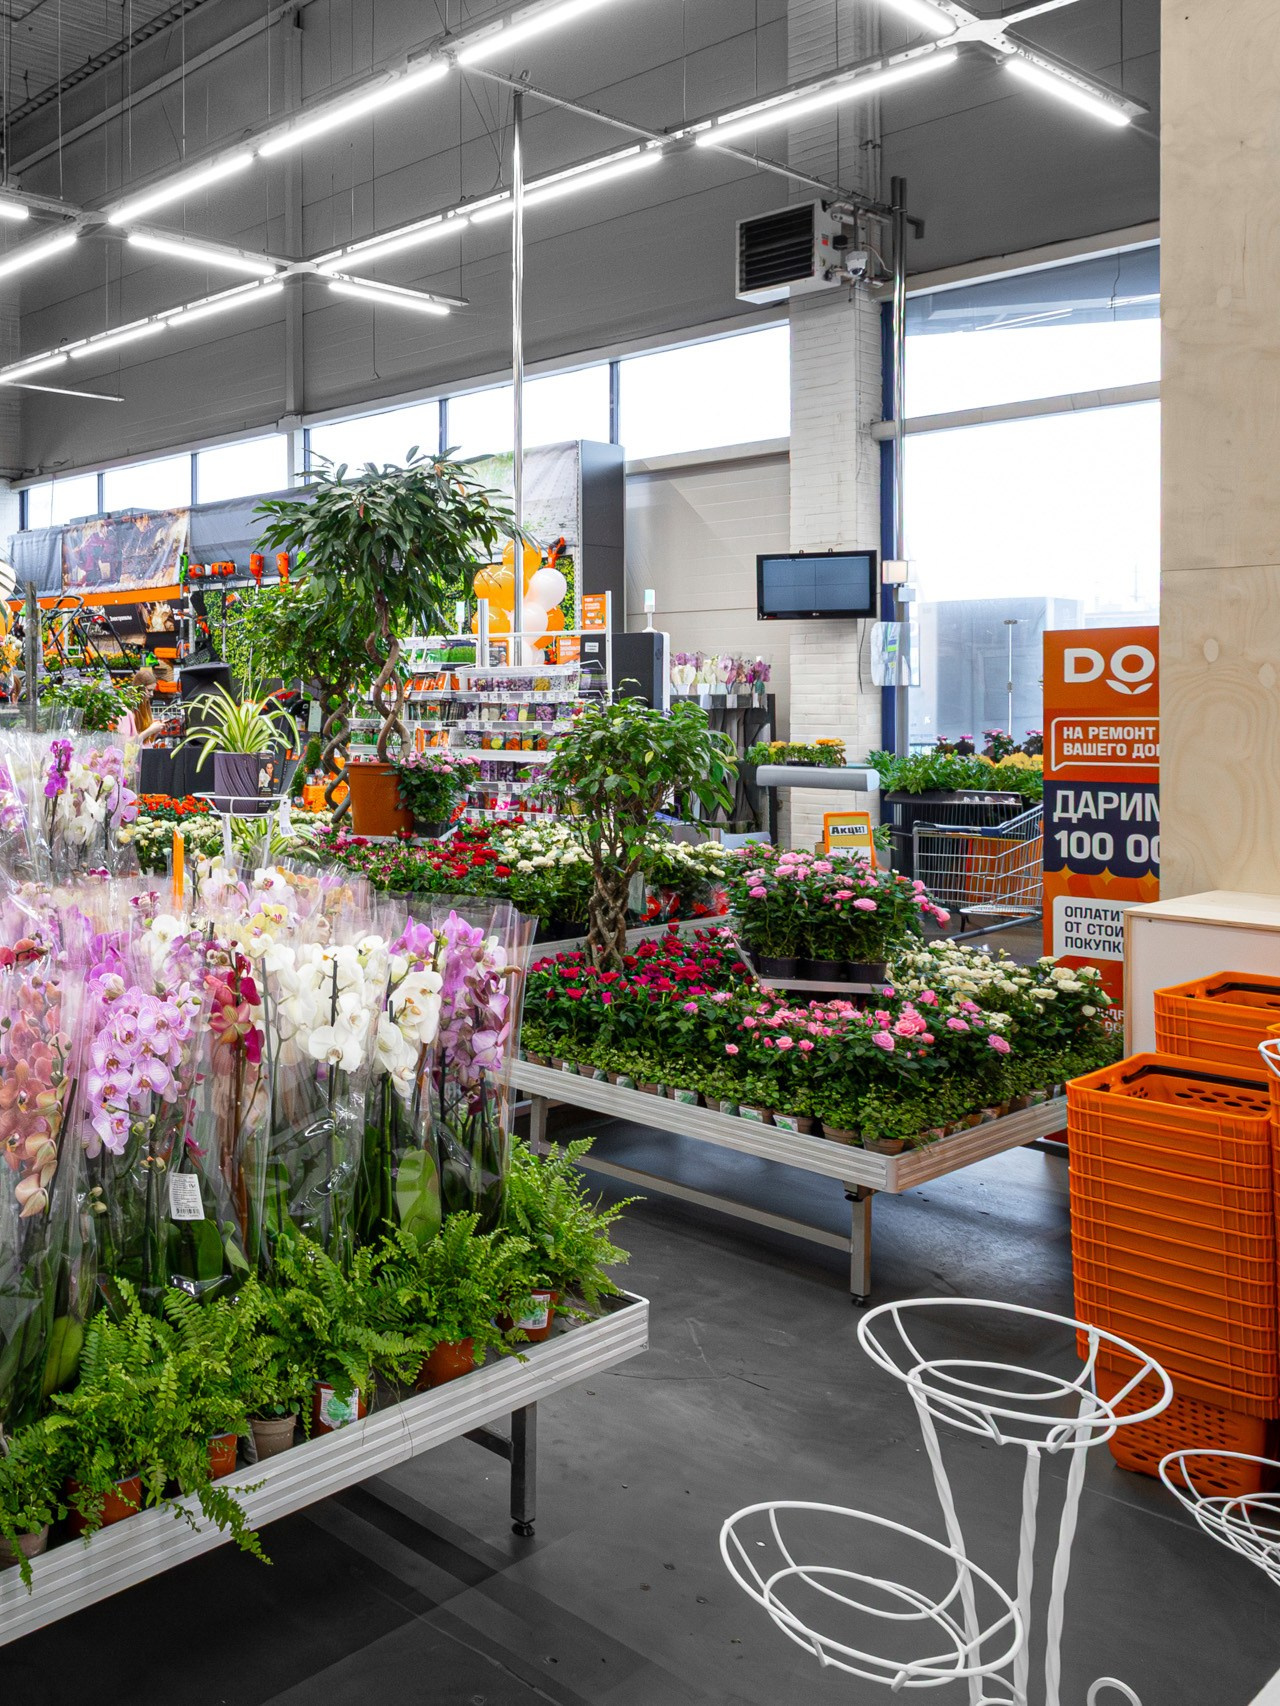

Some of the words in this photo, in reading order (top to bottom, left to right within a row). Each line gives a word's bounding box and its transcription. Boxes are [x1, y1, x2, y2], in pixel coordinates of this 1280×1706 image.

[1064, 645, 1156, 684] DO
[1063, 726, 1083, 740] НА
[1088, 726, 1156, 740] РЕМОНТ
[1063, 743, 1127, 756] ВАШЕГО
[1132, 744, 1159, 759] ДО
[1054, 830, 1114, 861] 100
[1064, 921, 1081, 934] ОТ
[1064, 936, 1124, 954] ПОКУПК
